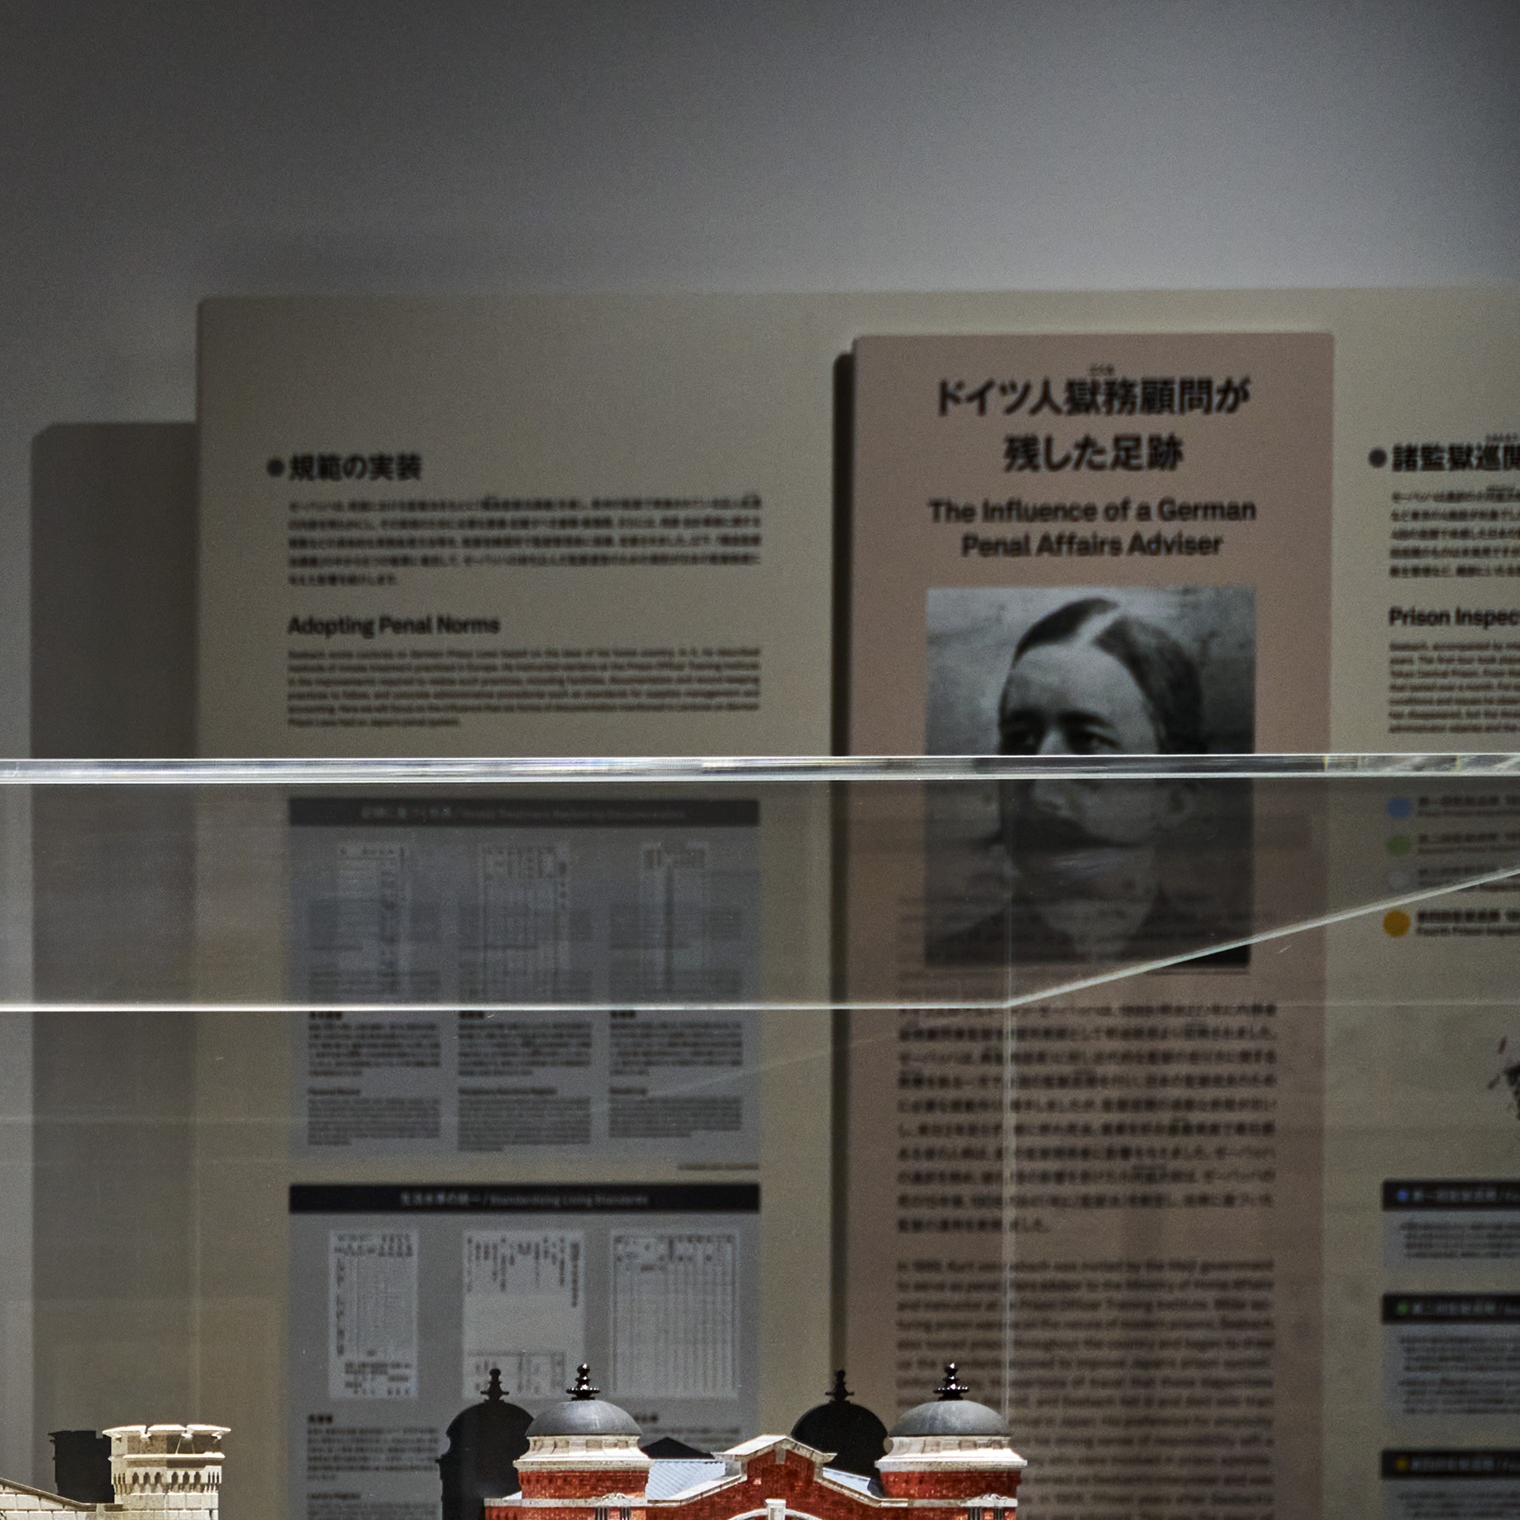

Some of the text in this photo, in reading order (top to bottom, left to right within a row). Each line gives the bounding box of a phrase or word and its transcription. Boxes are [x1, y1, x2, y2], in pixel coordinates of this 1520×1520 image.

[938, 377, 1251, 417] ドイツ人獄務顧問が
[289, 452, 422, 481] 規範の実装
[1004, 433, 1183, 473] 残した足跡
[929, 497, 1256, 523] The Influence of a German
[963, 531, 1222, 558] Penal Affairs Adviser
[289, 615, 499, 639] Adopting Penal Norms
[1389, 607, 1450, 626] Prison
